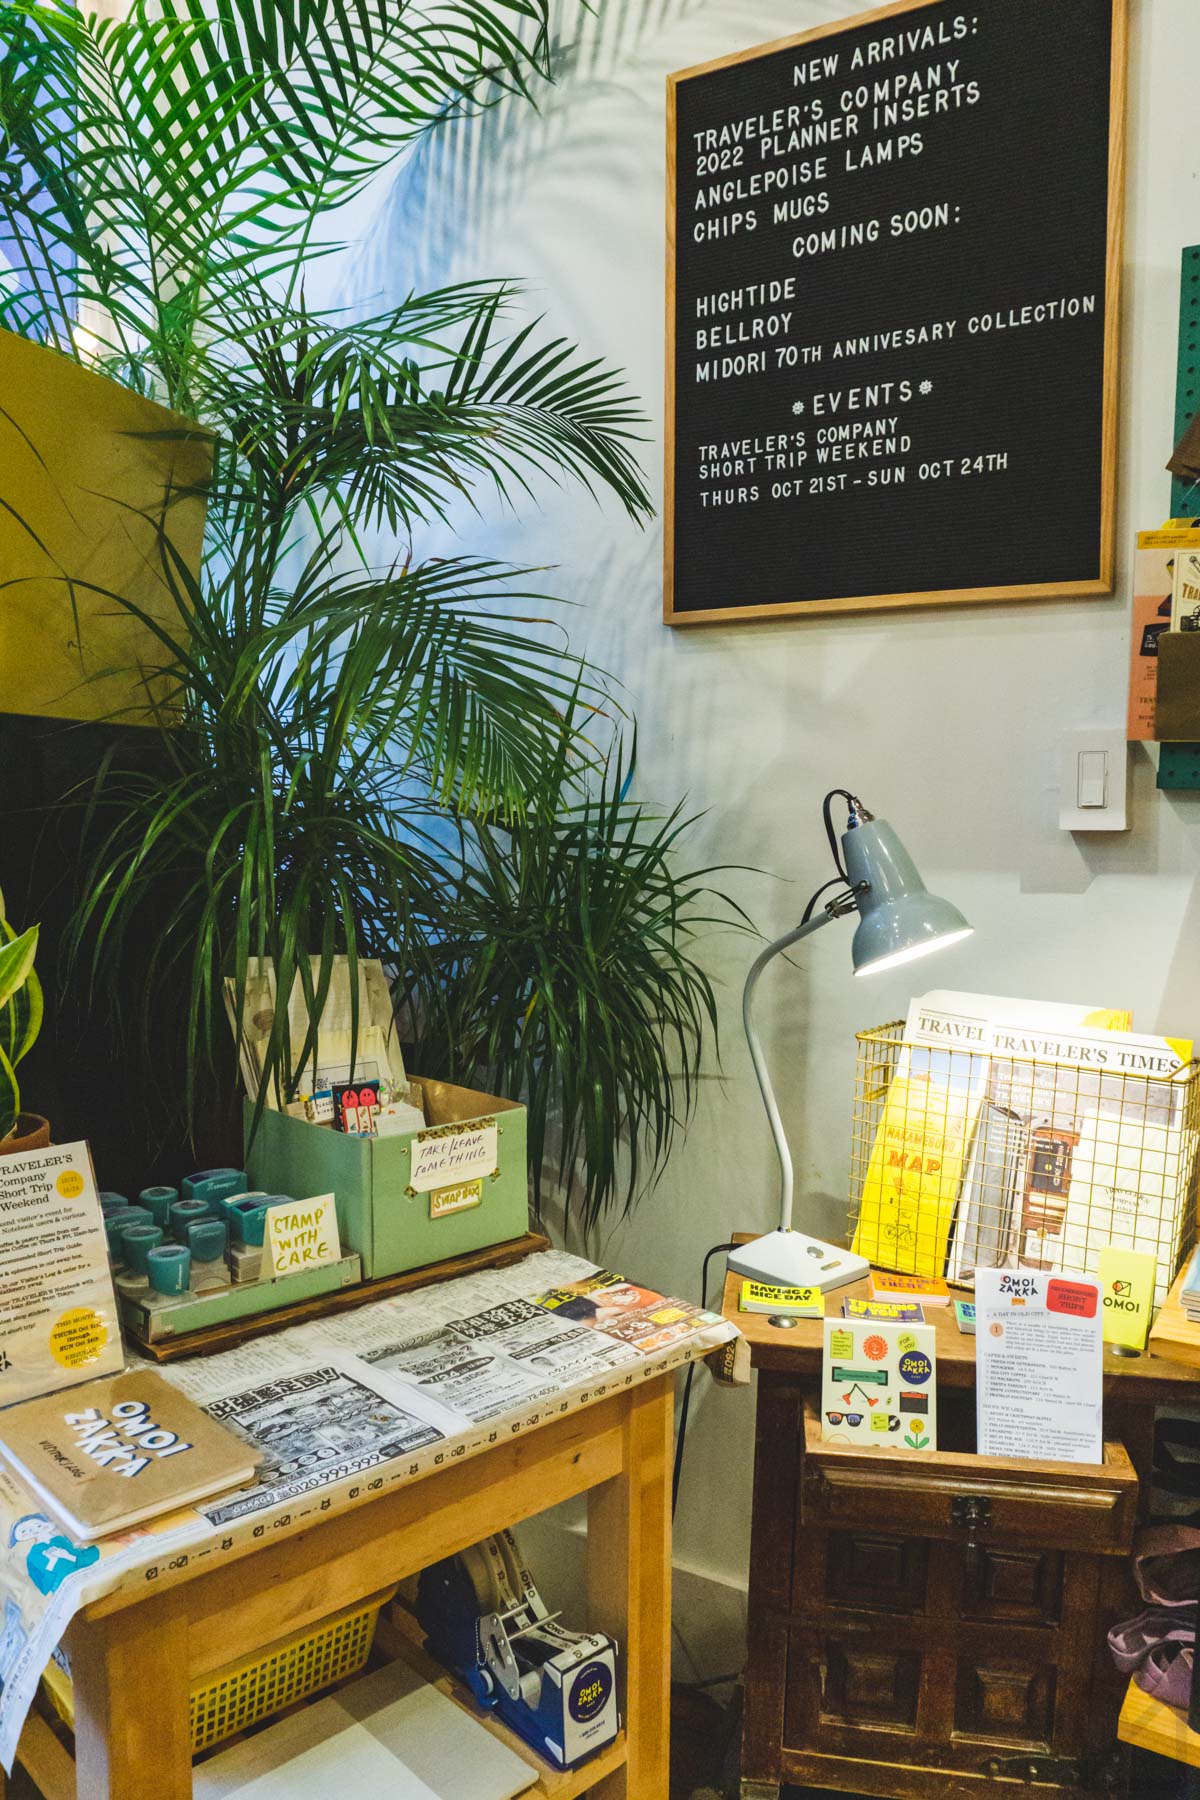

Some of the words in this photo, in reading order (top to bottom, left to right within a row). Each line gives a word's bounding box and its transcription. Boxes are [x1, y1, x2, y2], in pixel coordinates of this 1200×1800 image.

[793, 53, 839, 87] NEW
[850, 15, 978, 71] ARRIVALS:
[693, 99, 824, 153] TRAVELER'S
[840, 59, 960, 113] COMPANY
[696, 145, 744, 177] 2022
[760, 113, 859, 160] PLANNER
[873, 80, 981, 130] INSERTS
[694, 156, 828, 211] ANGLEPOISE
[845, 132, 924, 172] LAMPS
[693, 209, 758, 243] CHIPS
[773, 191, 830, 225] MUGS
[792, 219, 880, 258] COMING
[890, 202, 961, 237] SOON:
[696, 277, 797, 318] HIGHTIDE
[695, 350, 766, 383] MIDORI
[774, 344, 822, 369] 70TH
[832, 320, 957, 359] ANNIVESARY
[967, 294, 1095, 334] COLLECTION
[696, 311, 793, 351] BELLROY
[813, 380, 913, 416] EVENTS
[698, 431, 806, 462] TRAVELER'S
[816, 416, 899, 445] COMPANY
[698, 457, 757, 480] SHORT
[764, 450, 808, 471] TRIP
[816, 435, 911, 464] WEEKEND
[699, 485, 760, 508] THURS
[771, 479, 804, 499] OCT
[808, 473, 848, 494] 21ST
[867, 466, 906, 487] SUN
[918, 459, 955, 481] OCT
[960, 452, 1008, 475] 24TH
[992, 1033, 1108, 1063] TRAVELER'S
[1117, 1051, 1180, 1073] TIMES
[0, 1154, 73, 1176] RAVELER'S
[414, 1147, 486, 1178] SOMETHING
[888, 1150, 941, 1174] MAP
[0, 1186, 27, 1200] Short
[29, 1183, 53, 1194] Trip
[0, 1194, 50, 1212] Weekend
[434, 1191, 462, 1209] SWAP
[45, 1209, 62, 1217] event
[273, 1207, 324, 1233] STAMP
[2, 1223, 34, 1234] Notebook
[36, 1219, 53, 1227] users
[278, 1228, 318, 1251] WITH
[275, 1241, 329, 1271] CARE
[749, 1289, 782, 1300] NICE
[750, 1284, 801, 1295] HAVING
[999, 1284, 1039, 1297] ZAKKA
[1002, 1275, 1034, 1288] OMOI
[1103, 1297, 1140, 1313] OMOI
[899, 1336, 910, 1346] FOR
[903, 1342, 915, 1351] YOU
[901, 1363, 930, 1374] ZAKKA
[904, 1358, 928, 1367] OMOI
[112, 1401, 194, 1458] OMOI
[64, 1408, 152, 1478] ZAKKA
[288, 1454, 380, 1494] 0120-999-999
[577, 1687, 603, 1706] ZAKKA
[580, 1680, 601, 1697] OMOI
